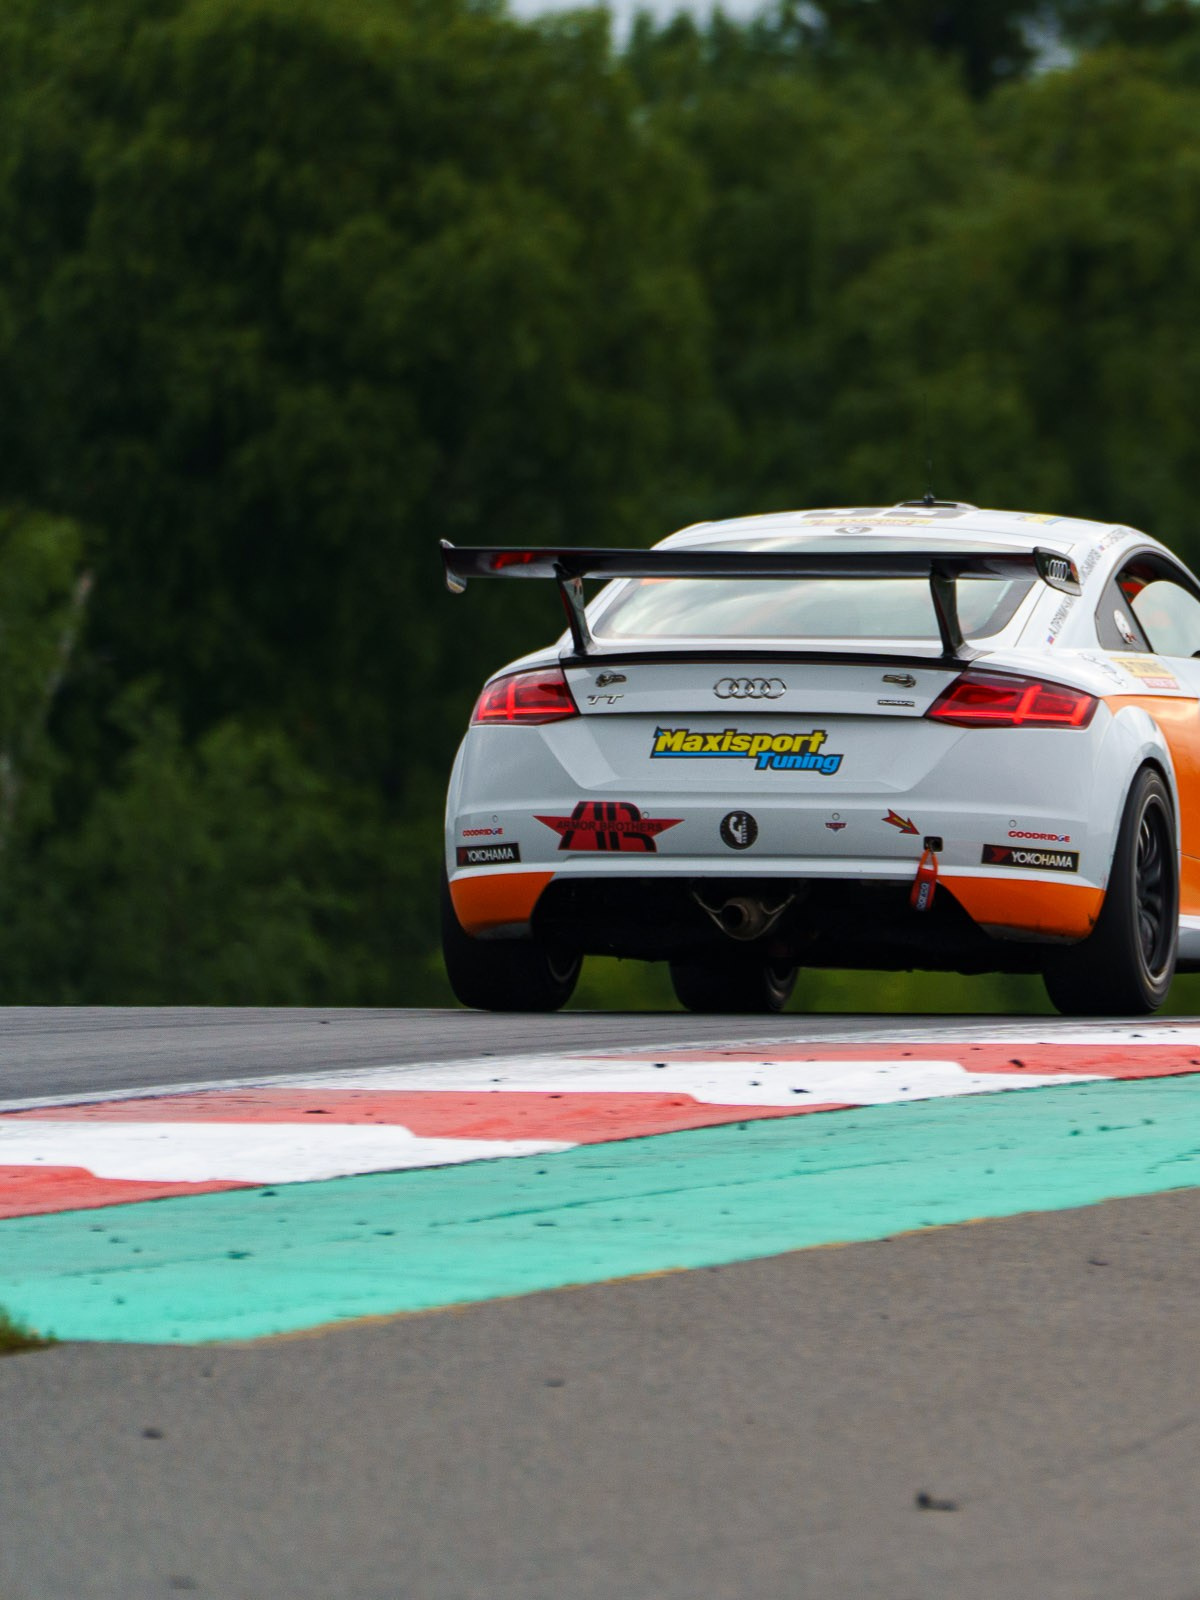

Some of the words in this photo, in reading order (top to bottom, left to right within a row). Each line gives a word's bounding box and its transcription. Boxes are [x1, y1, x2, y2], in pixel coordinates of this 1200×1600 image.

[587, 694, 624, 705] TT
[653, 728, 827, 757] Maxisport
[756, 752, 842, 775] Tuning
[557, 820, 596, 832] ARMOR
[600, 821, 664, 833] BROTHERS
[1008, 830, 1071, 843] GOODRIDGE
[467, 847, 515, 862] YOKOHAMA
[1011, 850, 1073, 868] YOKOHAMA
